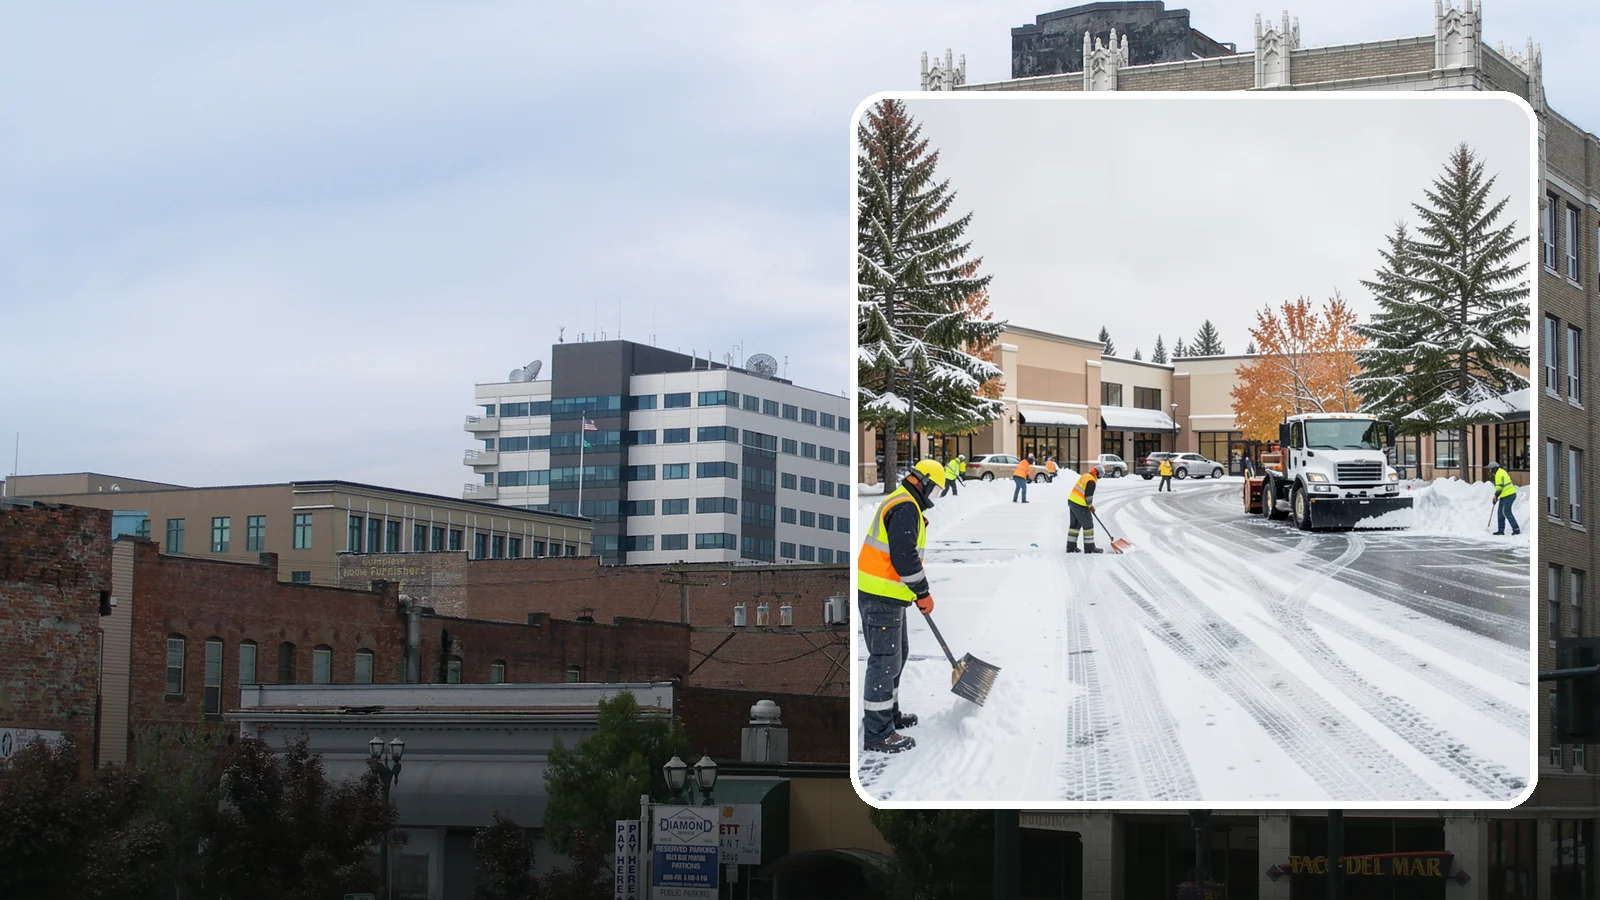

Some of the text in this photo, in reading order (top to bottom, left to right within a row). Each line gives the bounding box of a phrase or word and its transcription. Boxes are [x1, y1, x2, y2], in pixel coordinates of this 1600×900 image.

[370, 566, 427, 576] Furnishers
[660, 818, 713, 832] DIAMOND
[1022, 815, 1069, 828] BUILDING
[656, 845, 716, 854] RESERVED PARKING
[616, 825, 625, 893] PAY HERE
[627, 824, 636, 893] PAY HERE
[721, 851, 739, 861] Soup
[671, 862, 701, 870] PATRONS
[1346, 856, 1385, 876] DEL
[1392, 857, 1442, 877] MAR
[660, 889, 710, 898] PUBLIC PARKING
